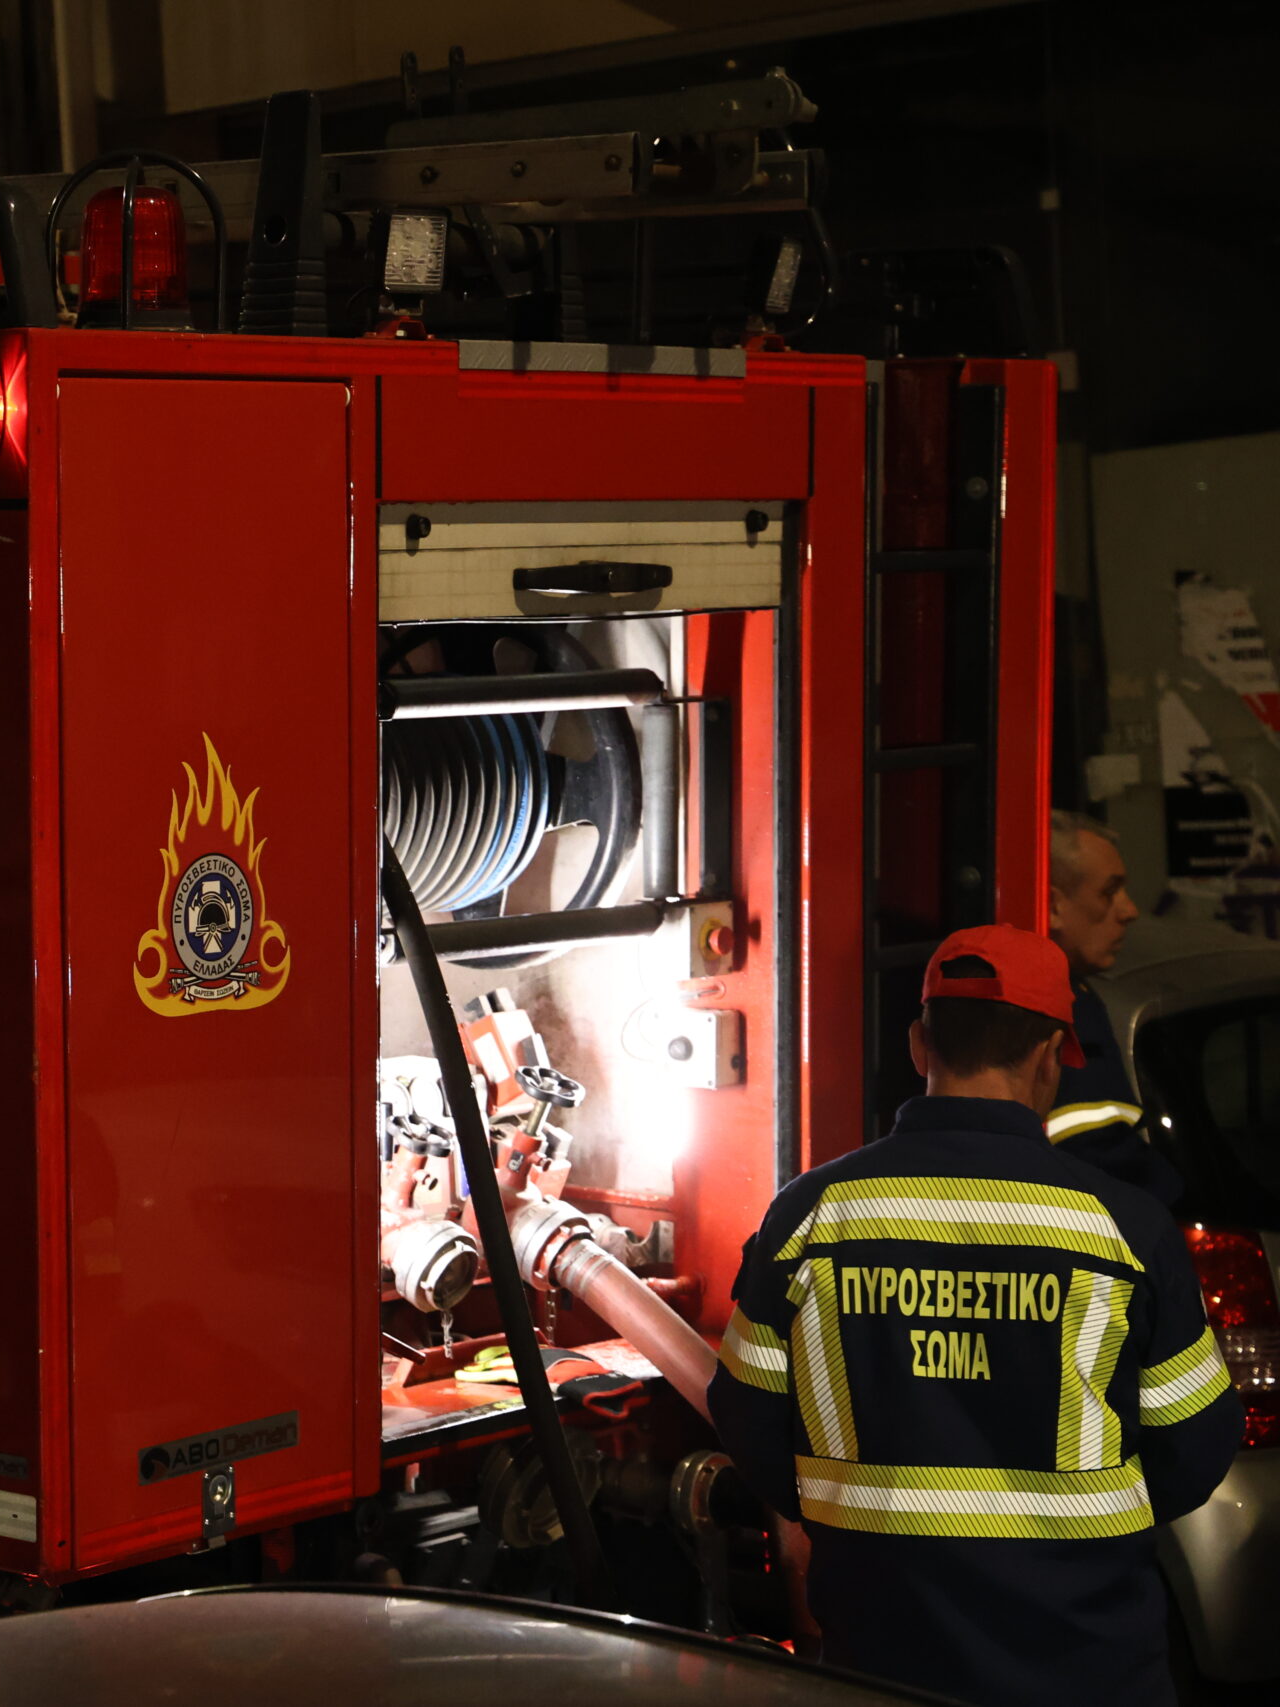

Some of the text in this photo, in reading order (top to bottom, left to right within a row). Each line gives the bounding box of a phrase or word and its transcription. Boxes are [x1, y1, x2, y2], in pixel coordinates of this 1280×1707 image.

[174, 859, 251, 924] ΠΥΡΟΣΒΕΣΤΙΚΟ ΣΩΜΑ
[192, 955, 235, 977] ΕΛΛΑΔΑΣ
[841, 1267, 1061, 1323] ΠΥΡΟΣΒΕΣΤΙΚΟ
[909, 1329, 992, 1381] ΣΩΜΑ
